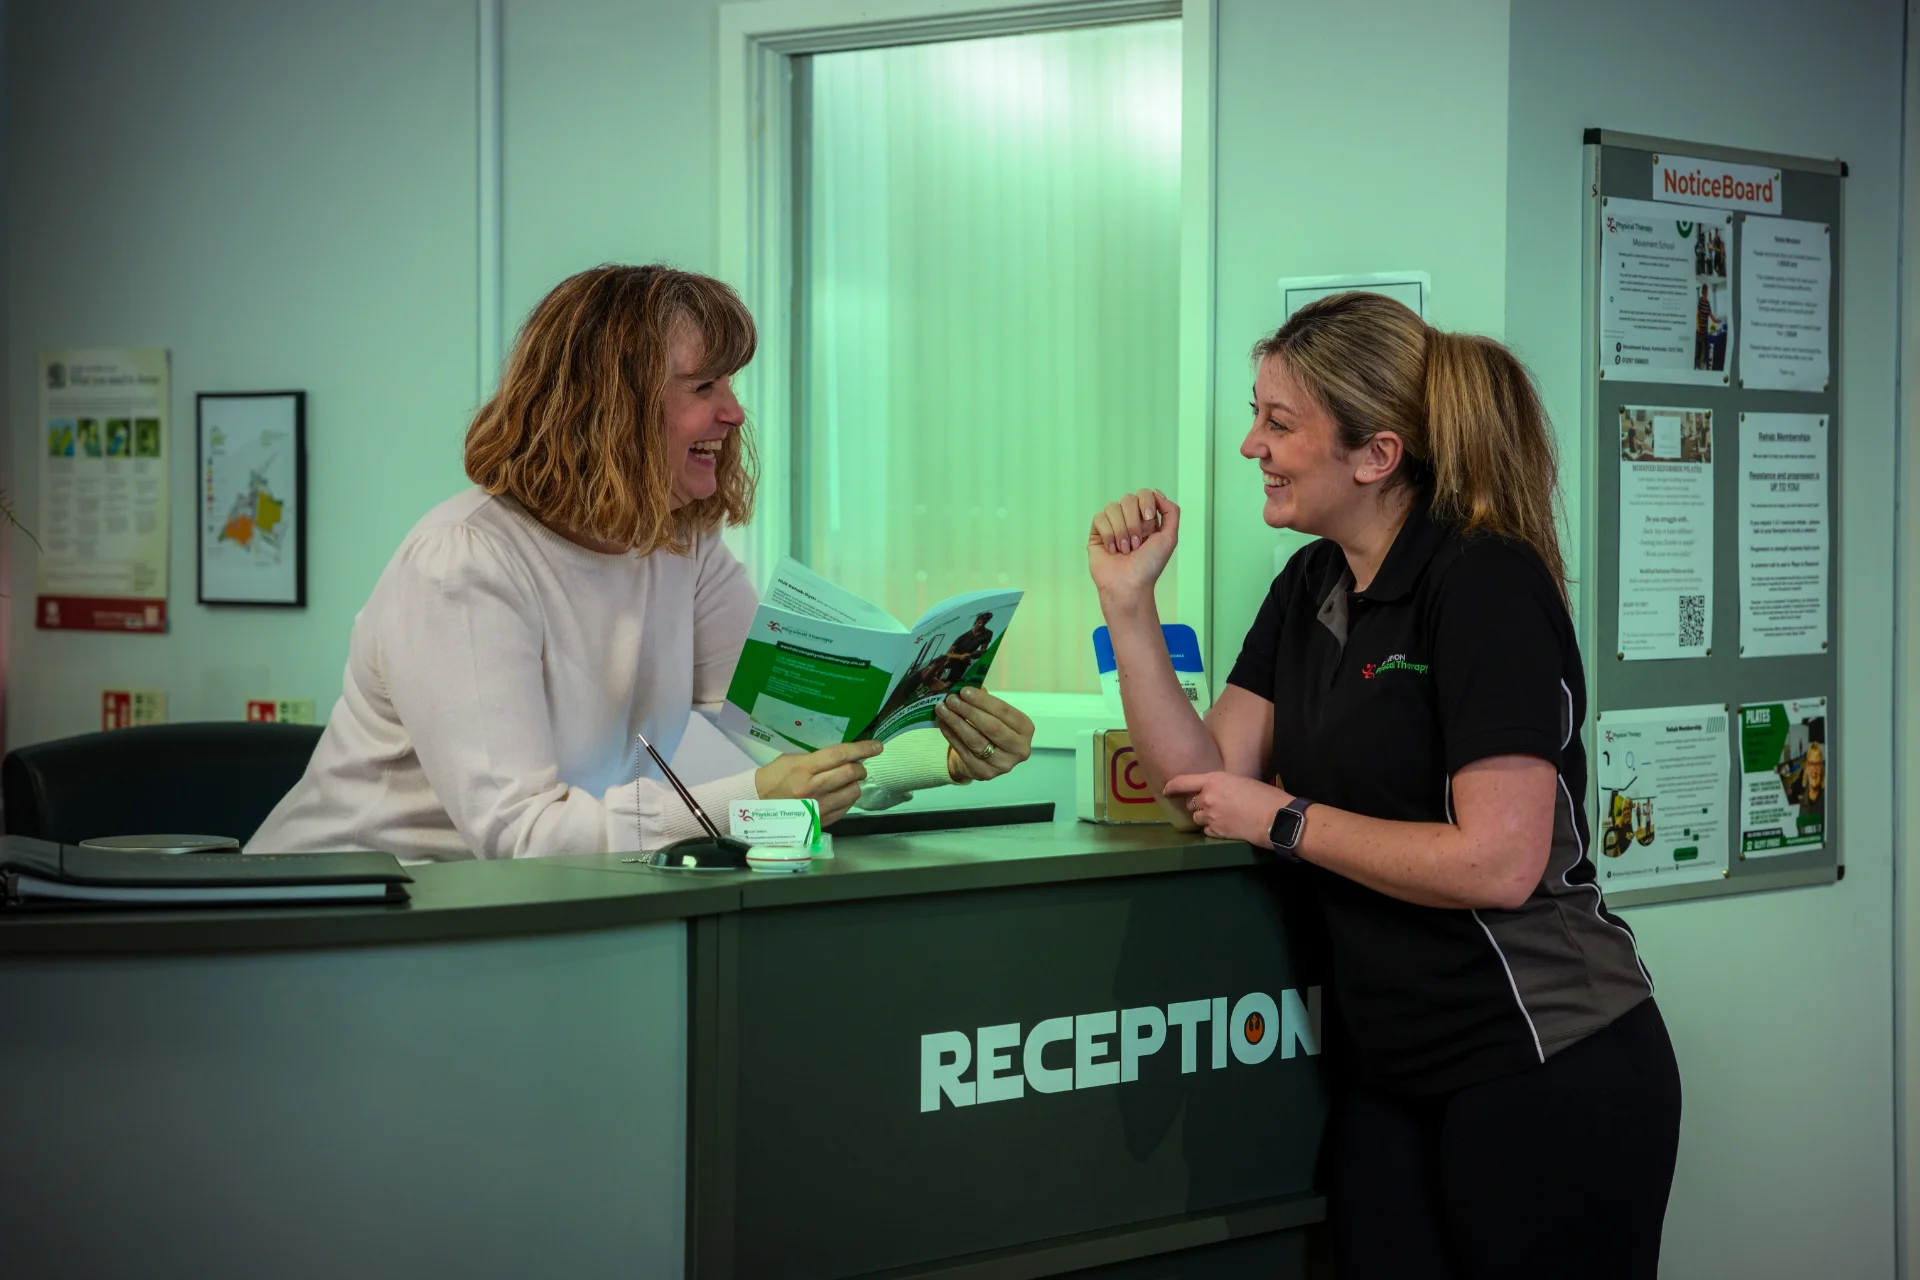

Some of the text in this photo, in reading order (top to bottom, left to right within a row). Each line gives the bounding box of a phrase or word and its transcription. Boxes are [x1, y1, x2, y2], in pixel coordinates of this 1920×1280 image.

[1664, 168, 1773, 203] NoticeBoard
[1616, 221, 1653, 233] Physical Therapy
[1633, 238, 1675, 250] Movement School
[1758, 432, 1775, 441] Rehab
[1777, 472, 1786, 480] and
[1770, 482, 1778, 491] UP
[1779, 482, 1786, 491] TO
[781, 626, 834, 644] Physical Therapy
[1396, 660, 1428, 674] Therapy
[907, 696, 942, 713] THERAPY
[1745, 708, 1771, 725] PILATES
[751, 810, 806, 819] Physical Therapy
[921, 985, 1322, 1113] RECEPTION
